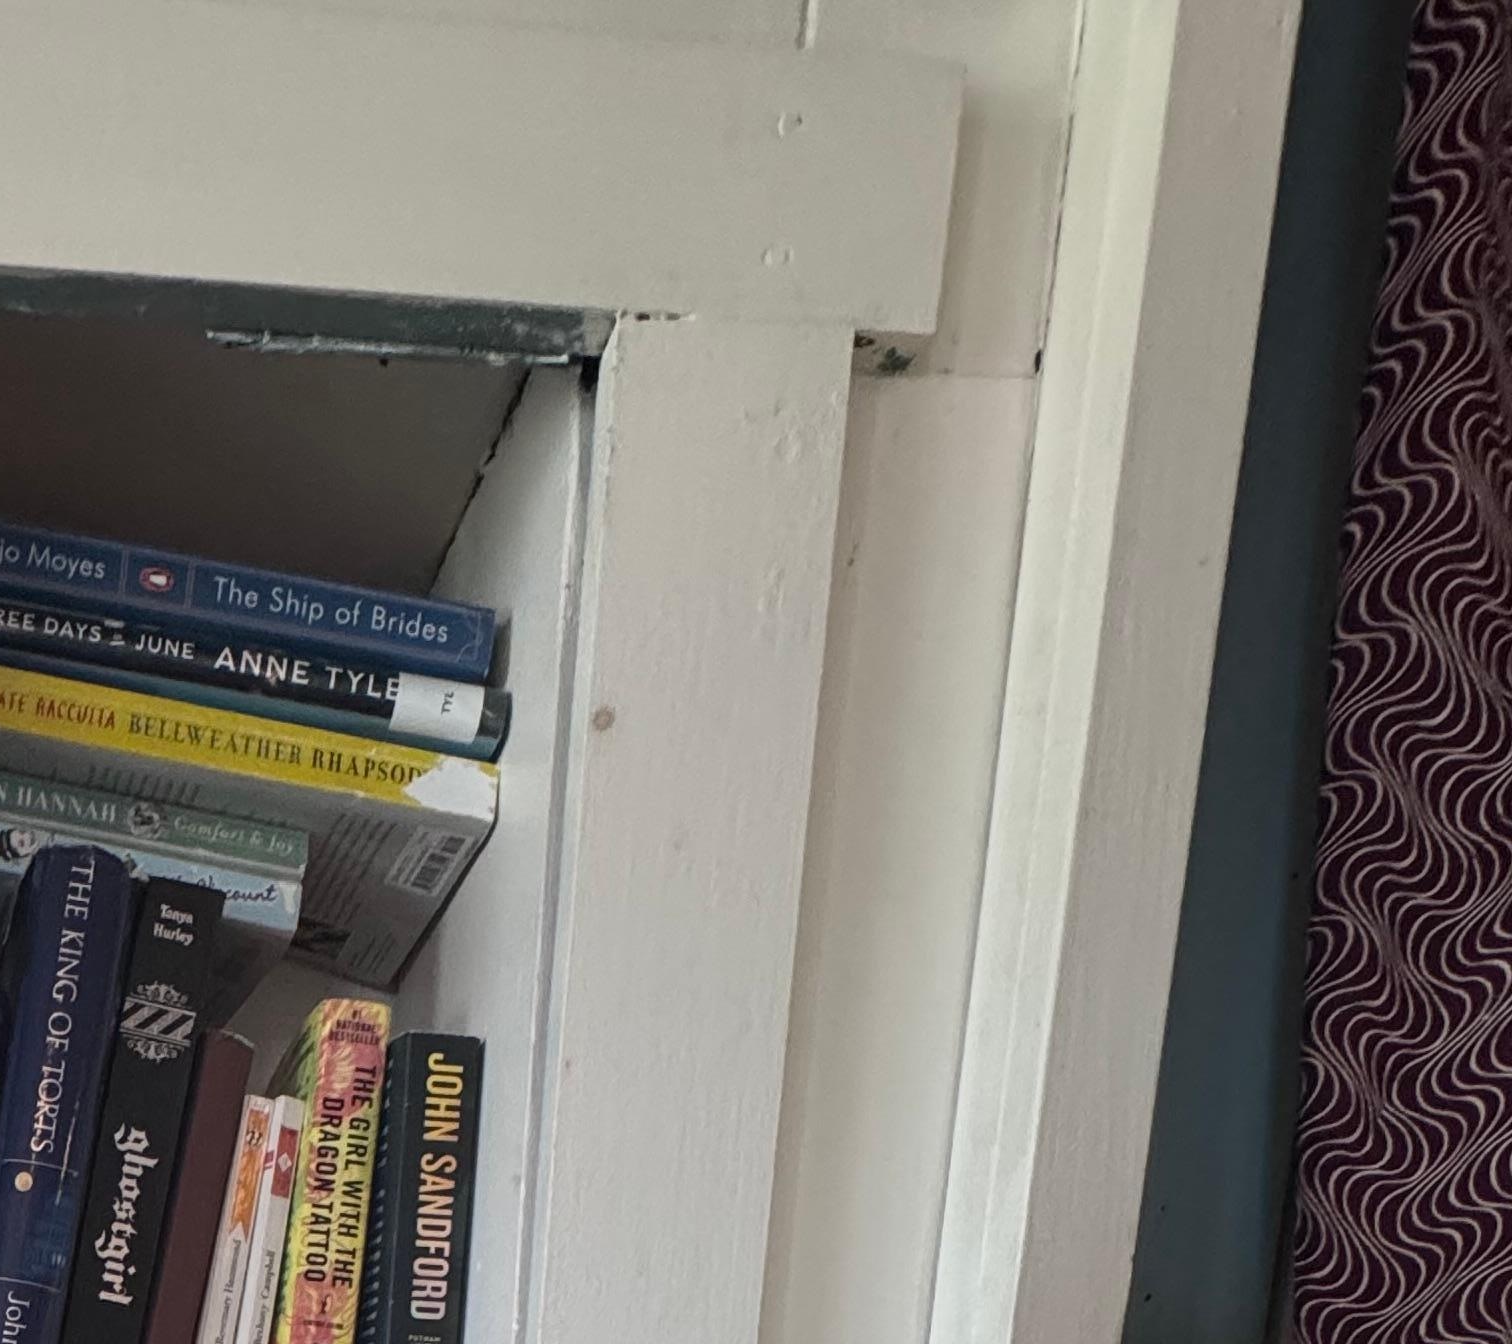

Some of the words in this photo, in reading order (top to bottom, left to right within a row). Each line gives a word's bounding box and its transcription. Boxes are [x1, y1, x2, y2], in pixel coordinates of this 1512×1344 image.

[25, 540, 108, 580] Moyes
[213, 576, 258, 609] The
[268, 586, 326, 626] Ship
[334, 599, 362, 626] of
[371, 604, 449, 644] Brides
[41, 617, 103, 643] DAYS
[134, 633, 195, 660] JUNE
[213, 646, 311, 686] ANNE
[128, 711, 304, 766] BELLWEATHER
[311, 746, 423, 784] RHAPSOD
[17, 787, 116, 823] HANNAH
[174, 816, 245, 843] Comfort
[63, 860, 95, 921] THE
[160, 904, 194, 924] Tanya
[153, 922, 194, 946] Hurley
[51, 929, 86, 1004] KING
[46, 1011, 73, 1052] OF
[30, 1060, 66, 1155] TORTS
[353, 1066, 376, 1109] THE
[422, 1052, 465, 1143] JOHN
[312, 1096, 345, 1193] DRAGON
[342, 1117, 371, 1171] GIRL
[337, 1180, 364, 1241] WITH
[409, 1152, 459, 1322] SANDFORD
[303, 1200, 334, 1283] TATTOO
[332, 1247, 356, 1290] THE
